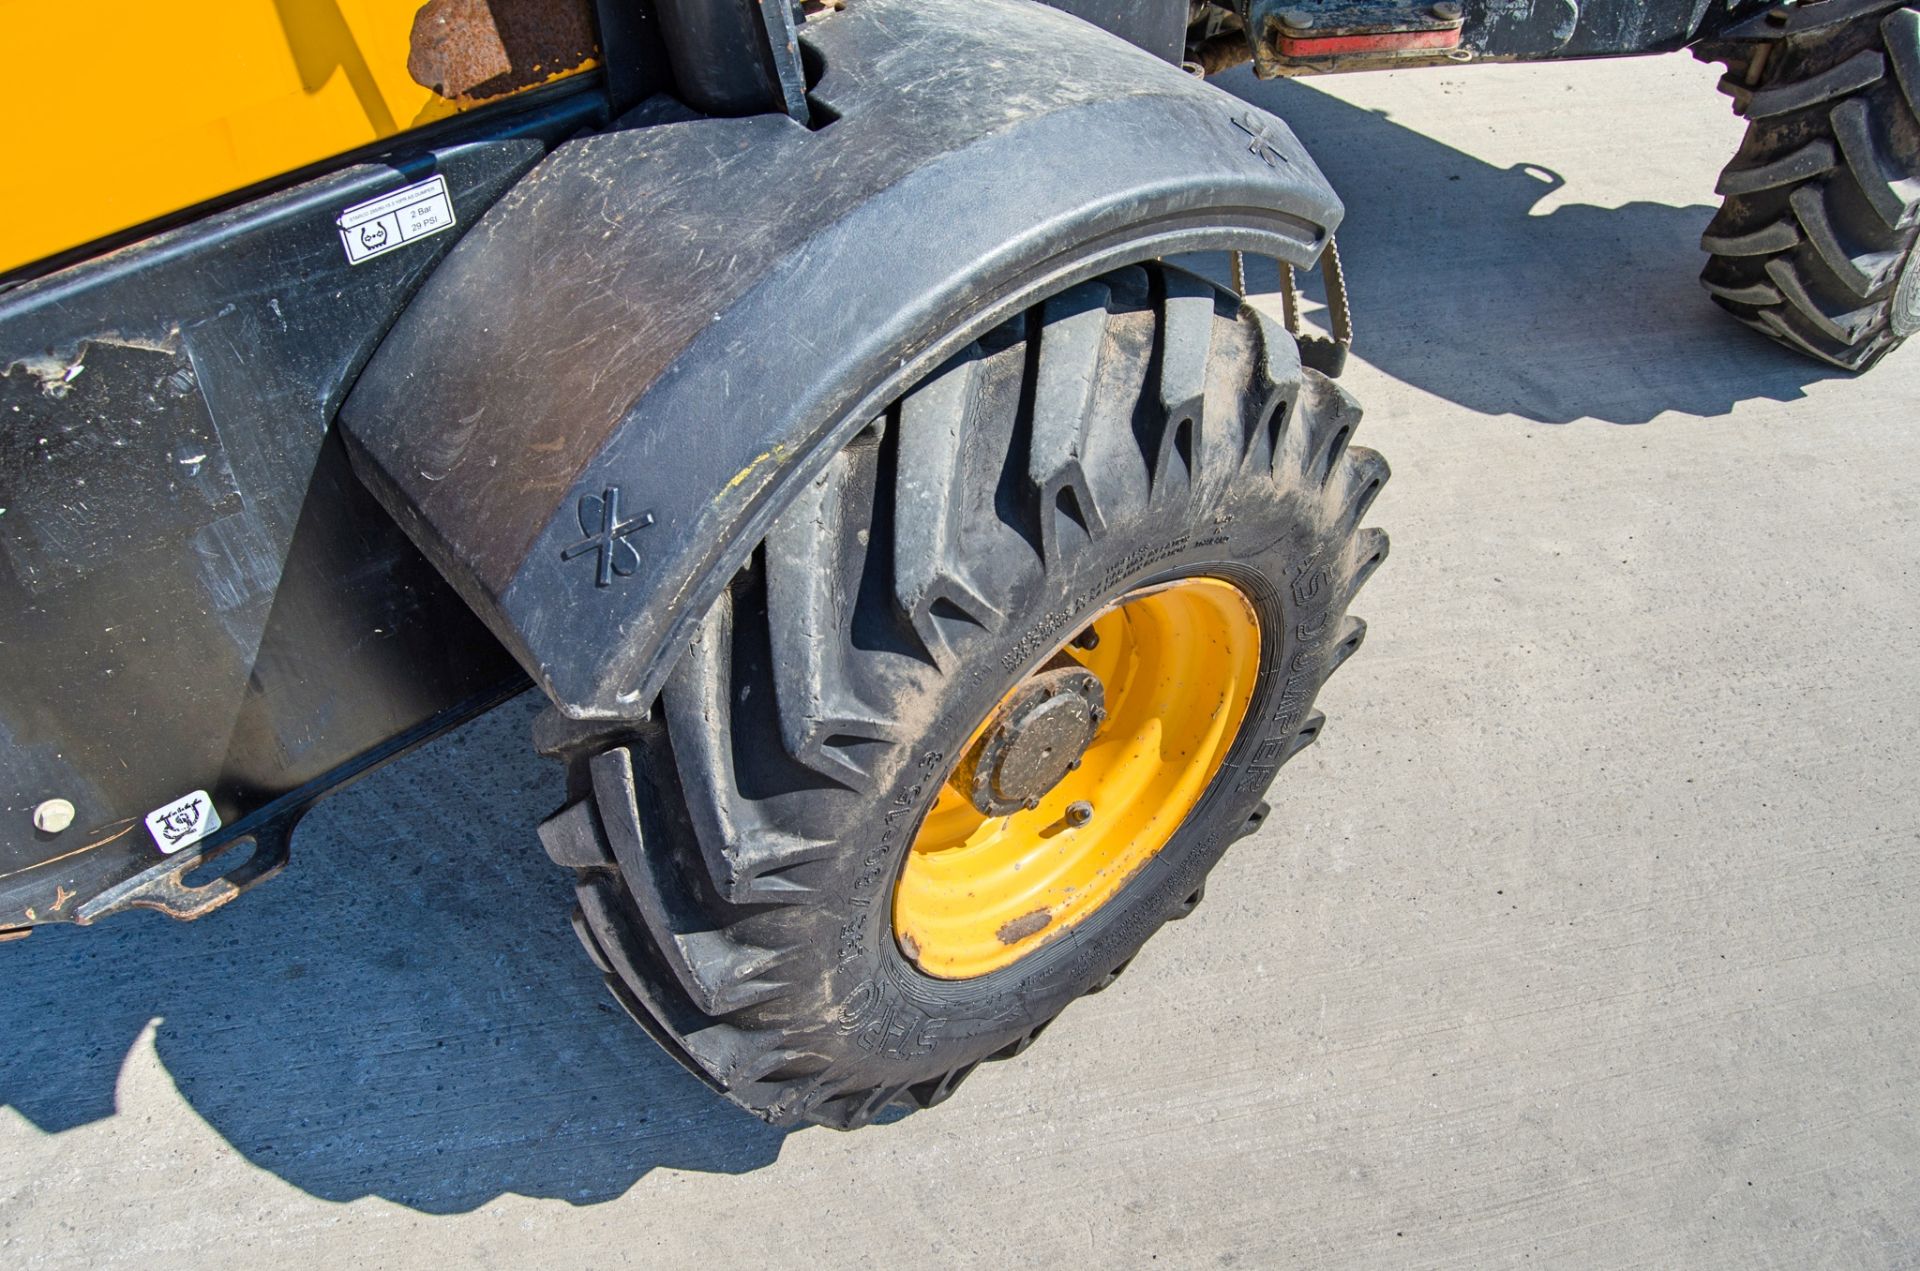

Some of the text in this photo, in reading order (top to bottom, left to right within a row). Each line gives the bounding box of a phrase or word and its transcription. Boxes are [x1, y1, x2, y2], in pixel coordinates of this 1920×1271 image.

[414, 186, 435, 197] DUMPER
[411, 206, 432, 218] 2 Bar
[411, 222, 422, 232] 29
[423, 216, 438, 227] PSI
[1235, 542, 1336, 793] AS DUMPER
